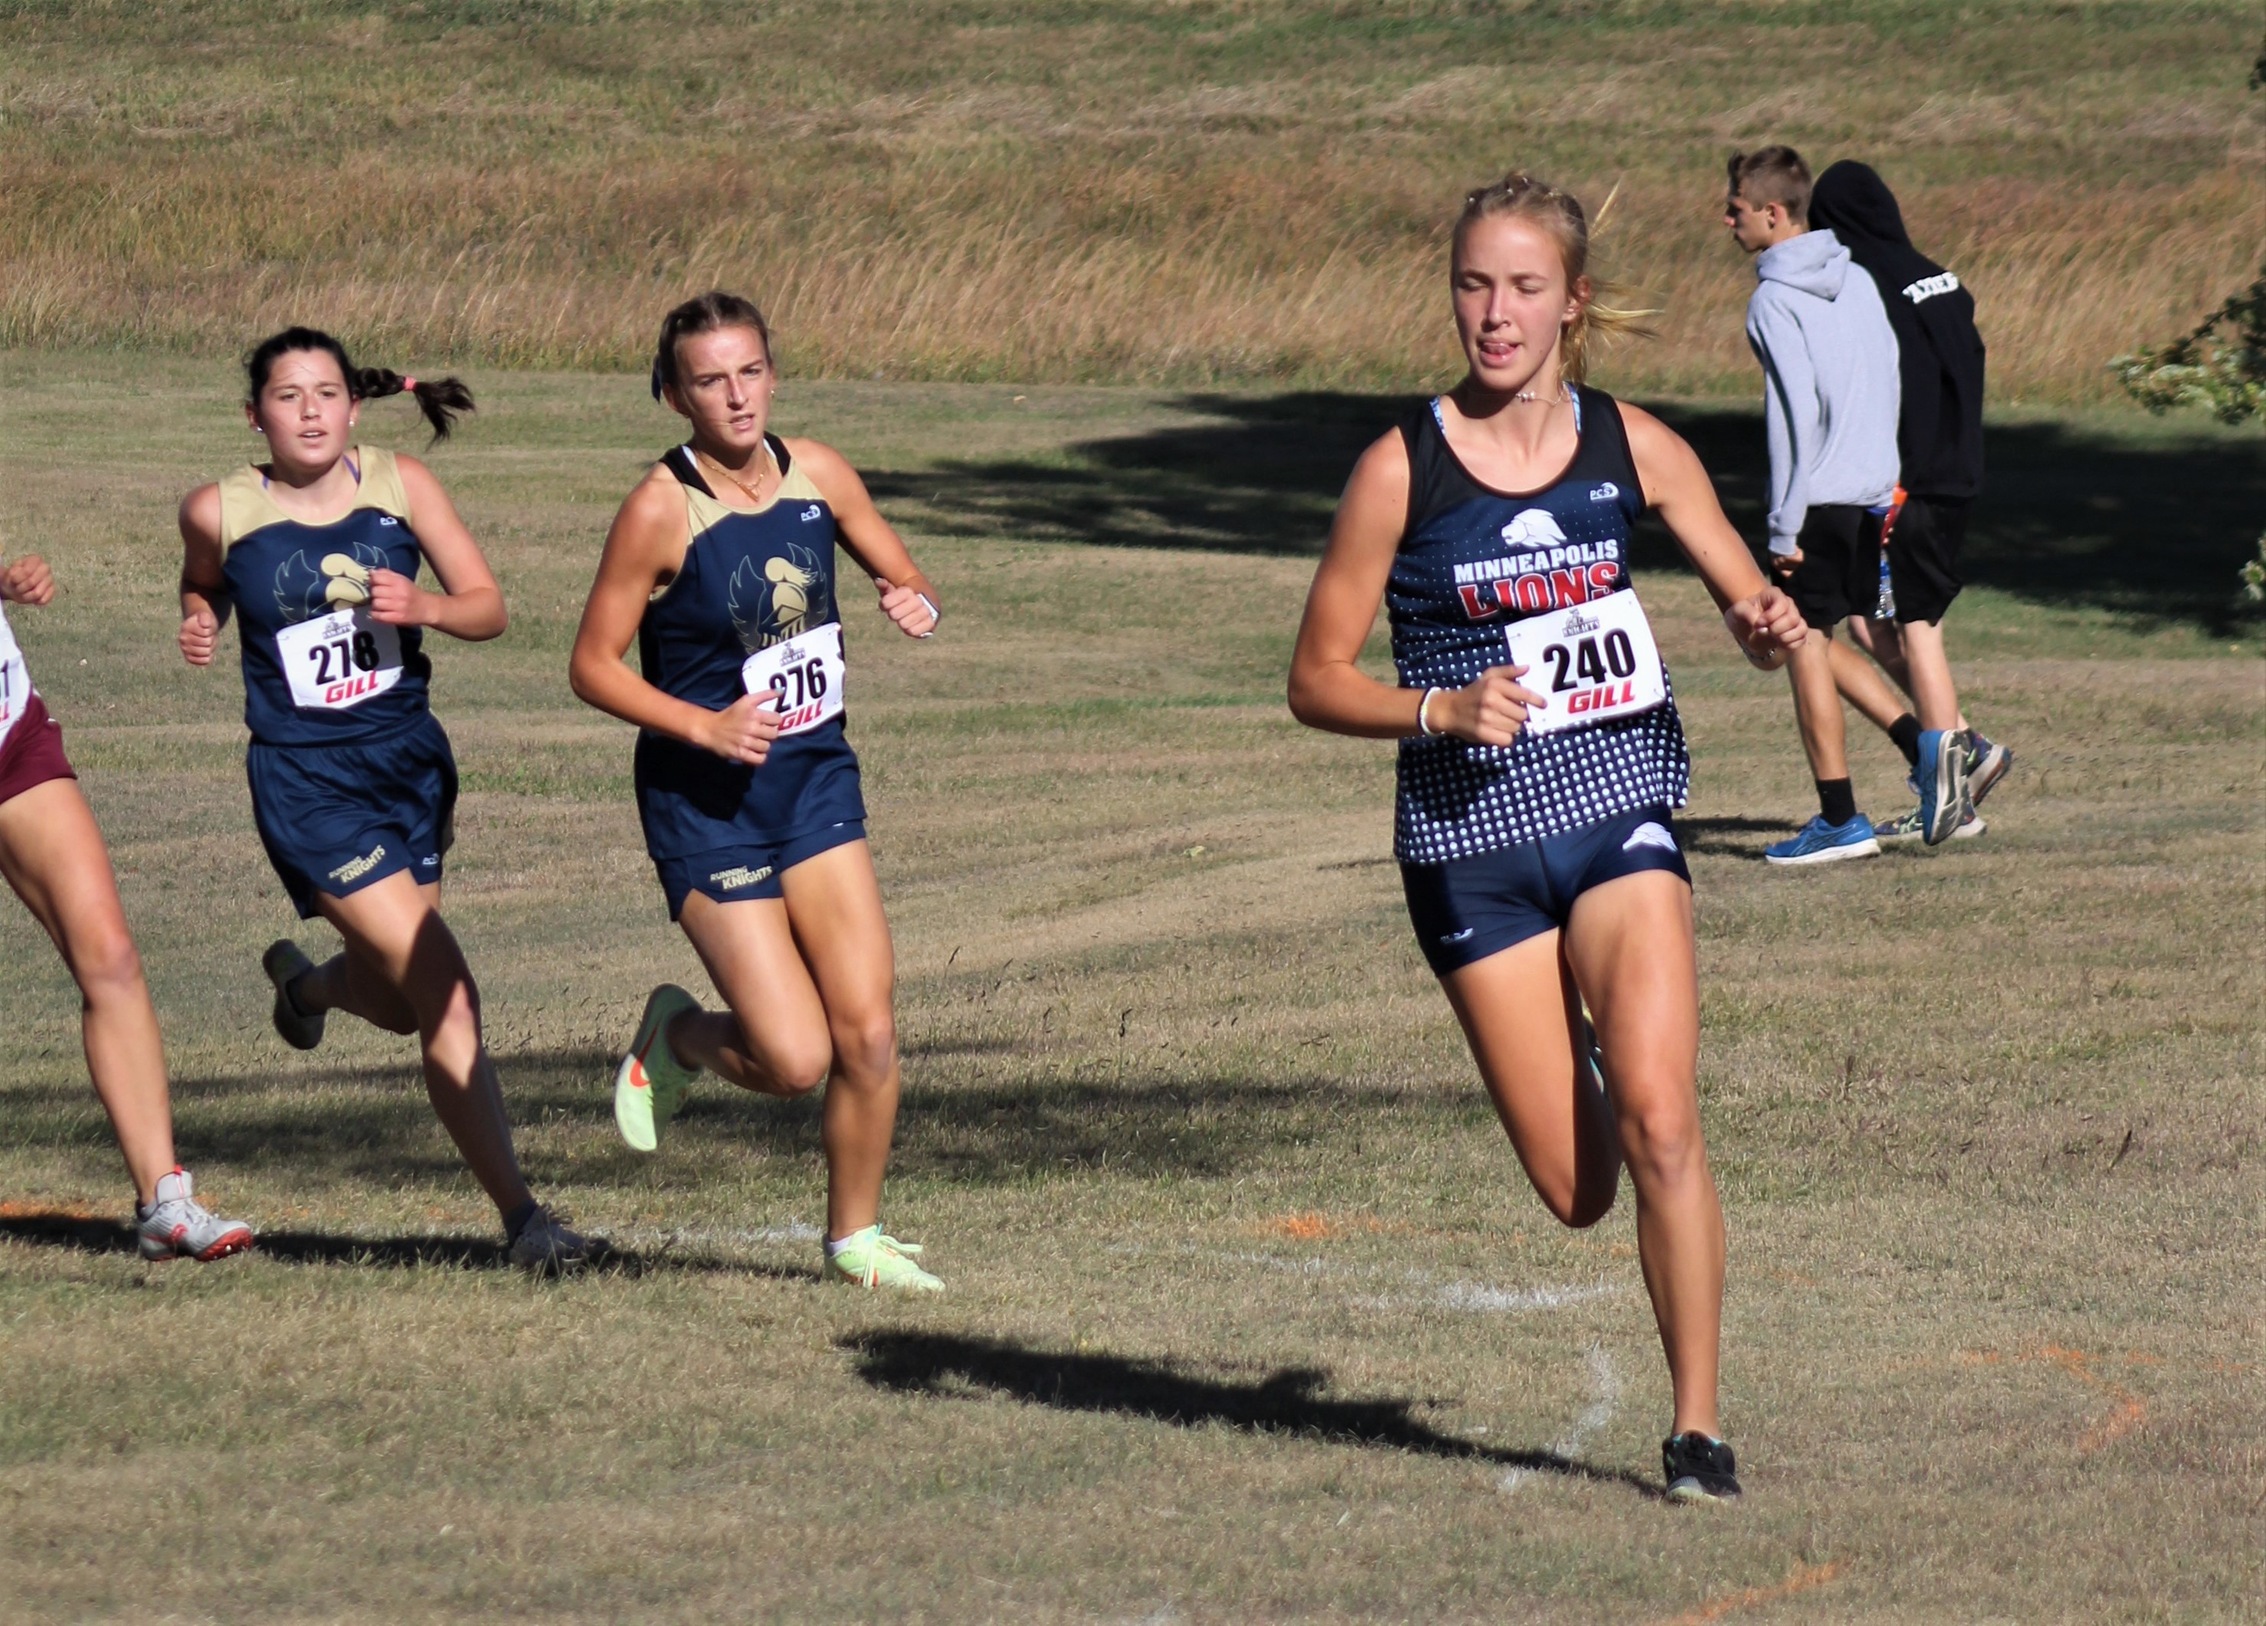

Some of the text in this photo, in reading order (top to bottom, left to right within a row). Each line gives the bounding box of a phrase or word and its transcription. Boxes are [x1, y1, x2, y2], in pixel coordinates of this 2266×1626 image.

[1453, 539, 1619, 584] MINNEAPOLIS
[1457, 560, 1620, 621] LIONS
[309, 630, 380, 686] 278
[1542, 628, 1637, 693] 240
[325, 669, 379, 704] GILL
[769, 657, 827, 714] 276
[1567, 679, 1636, 715] GILL
[777, 699, 824, 731] GILL
[340, 844, 386, 884] KNIGHTS
[710, 864, 749, 882] RUNNING
[722, 865, 774, 891] KNIGHTS
